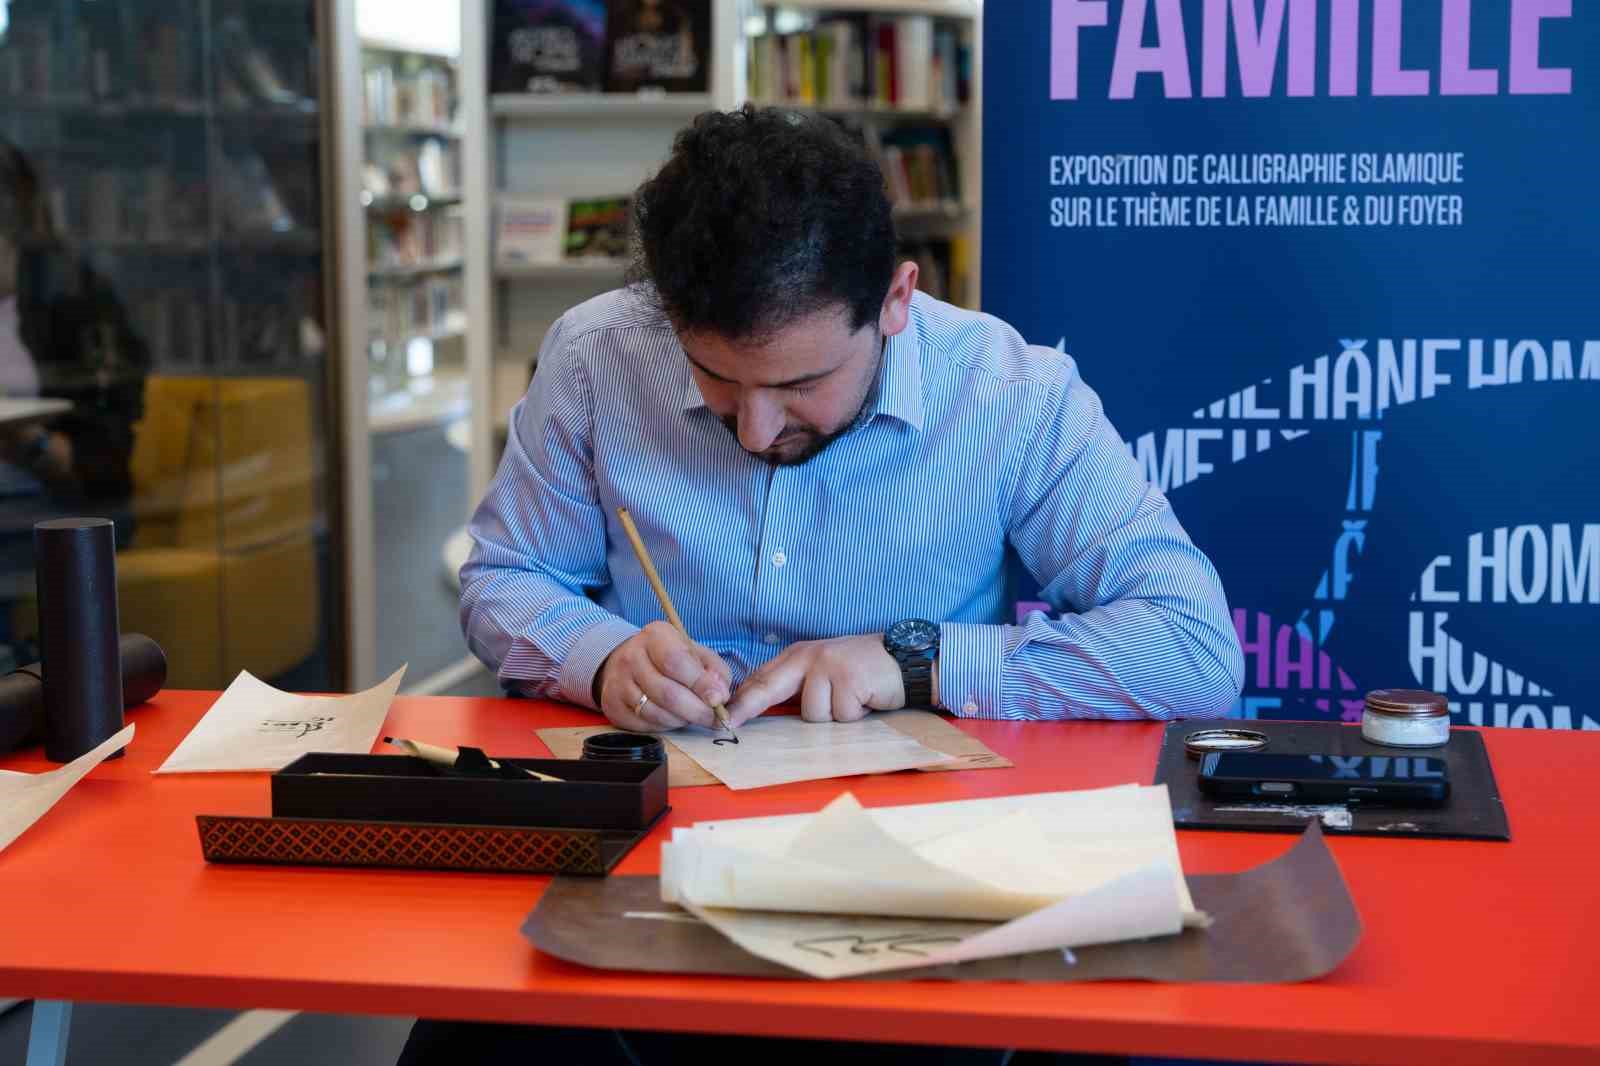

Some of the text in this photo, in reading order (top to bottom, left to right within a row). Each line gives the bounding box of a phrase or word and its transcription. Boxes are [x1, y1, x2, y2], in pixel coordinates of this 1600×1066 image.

[1050, 0, 1573, 99] FAMILLE
[1050, 152, 1464, 186] EXPOSITION DE CALLIGRAPHIE ISLAMIQUE
[1050, 191, 1463, 227] SUR LE THÈME DE LA FAMILLE & DU FOYER
